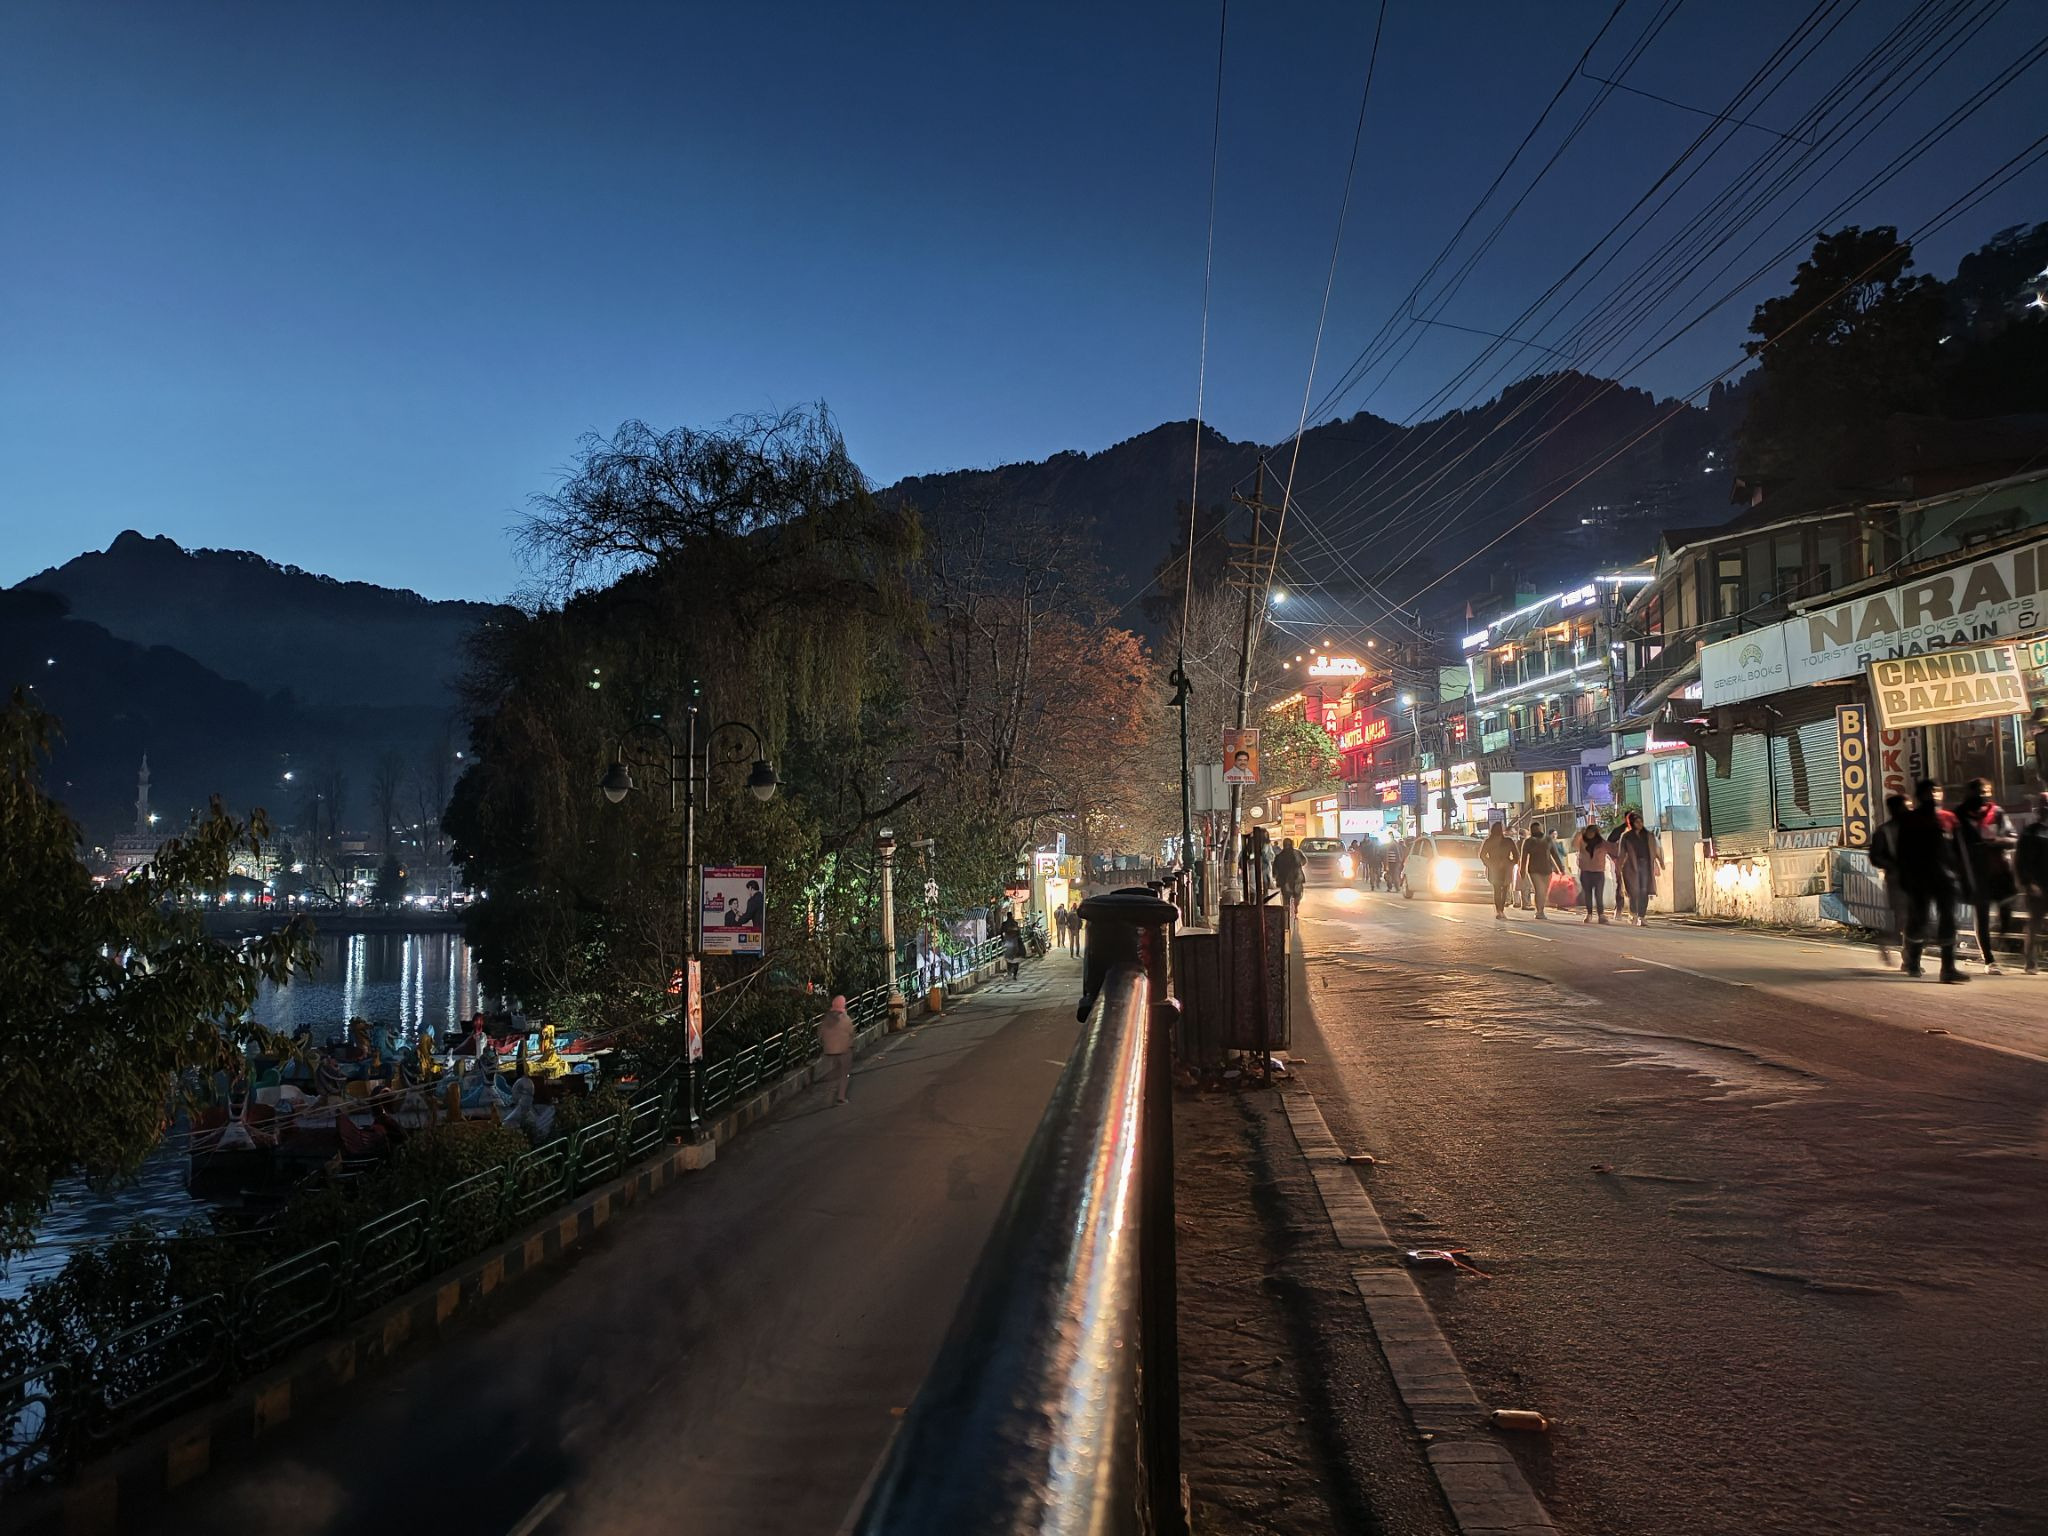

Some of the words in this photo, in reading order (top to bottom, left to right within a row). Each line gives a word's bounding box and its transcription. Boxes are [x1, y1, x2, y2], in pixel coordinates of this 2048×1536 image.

[1808, 544, 2048, 653] NARAI
[1801, 646, 1849, 666] TOURIST
[1854, 635, 1894, 654] GUIDE
[1901, 619, 1958, 642] BOOKS
[1985, 598, 2034, 619] MAPS
[1888, 621, 1998, 659] NARAIN
[1713, 675, 1746, 689] GENERAL
[1747, 664, 1783, 681] BOOKS
[1877, 648, 2014, 687] CANDLE
[1883, 675, 2022, 714] BAZAAR
[1586, 769, 1609, 777] Amul
[1842, 710, 1867, 845] BOOKS
[1775, 831, 1838, 849] NARAINS
[748, 934, 760, 943] LIC
